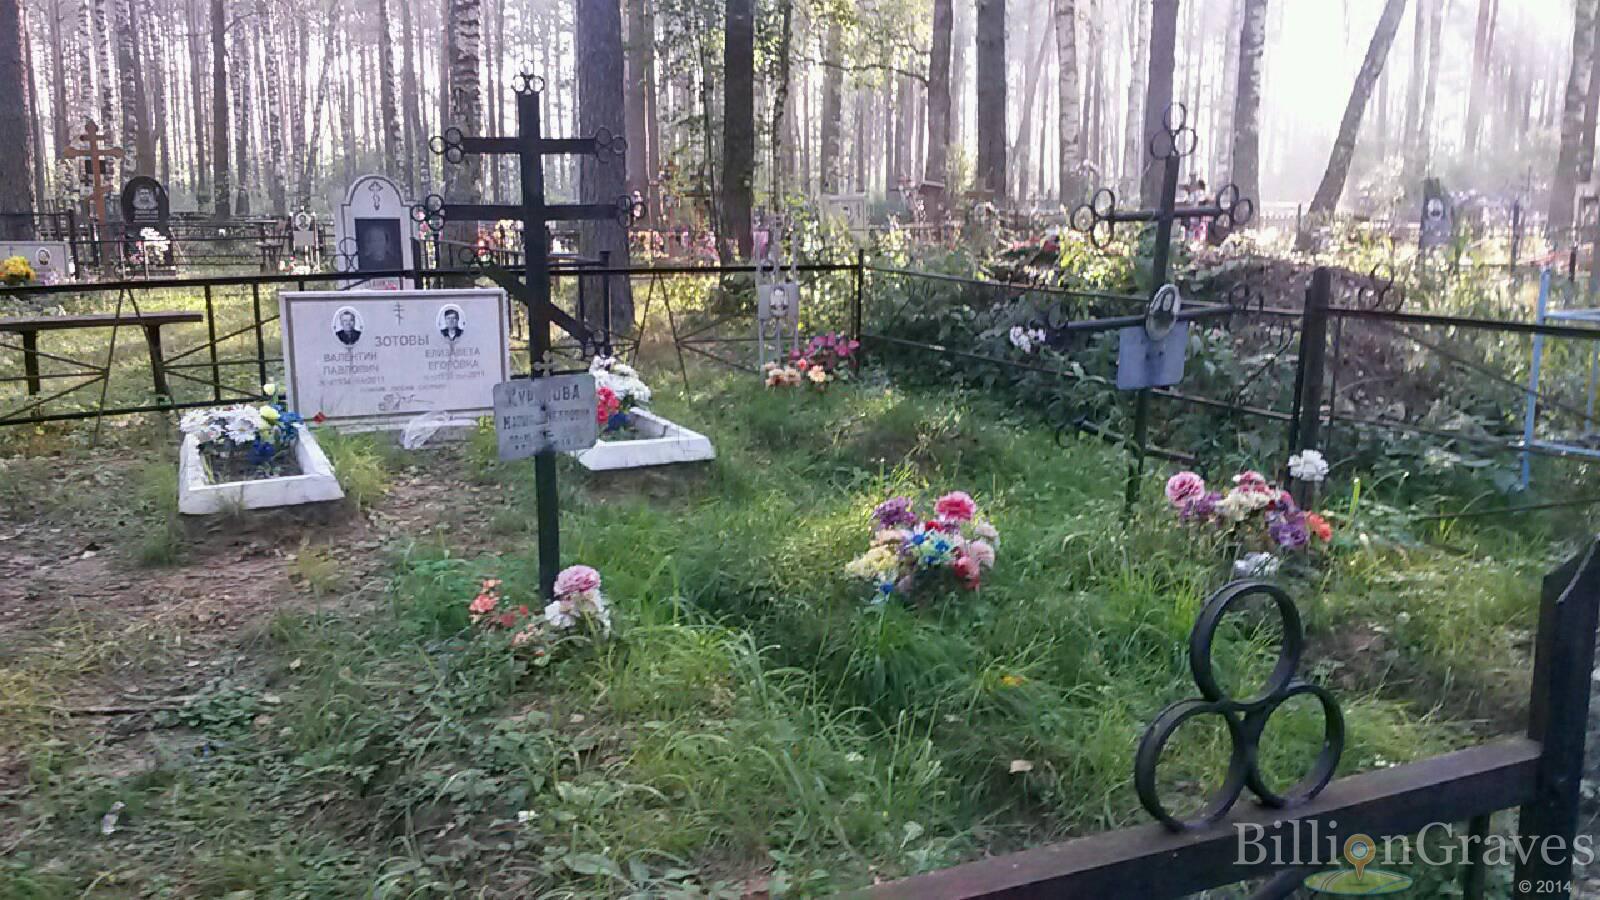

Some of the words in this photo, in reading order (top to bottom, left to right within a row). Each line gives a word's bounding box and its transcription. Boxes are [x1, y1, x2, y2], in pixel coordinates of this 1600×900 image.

[375, 335, 430, 347] ЗОТОВЫ
[323, 351, 377, 362] ВАЛЕНТИН
[424, 347, 481, 358] ЕЛИЗАВЕТА
